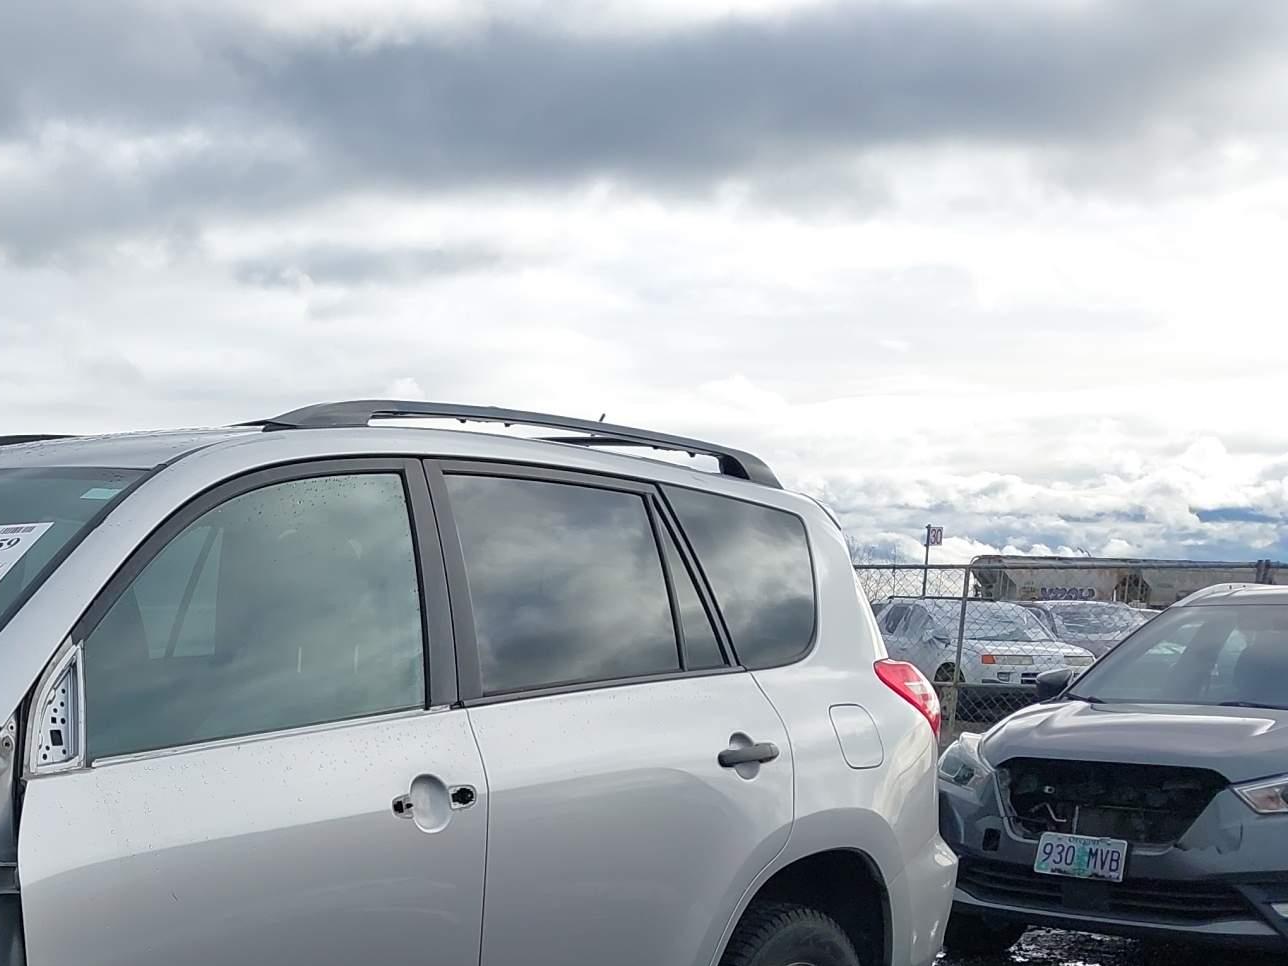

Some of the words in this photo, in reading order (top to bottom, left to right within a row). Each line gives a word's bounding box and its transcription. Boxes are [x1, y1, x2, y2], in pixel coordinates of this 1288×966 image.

[930, 528, 943, 545] 30
[1041, 842, 1076, 866] 930
[1086, 847, 1121, 873] MVB
